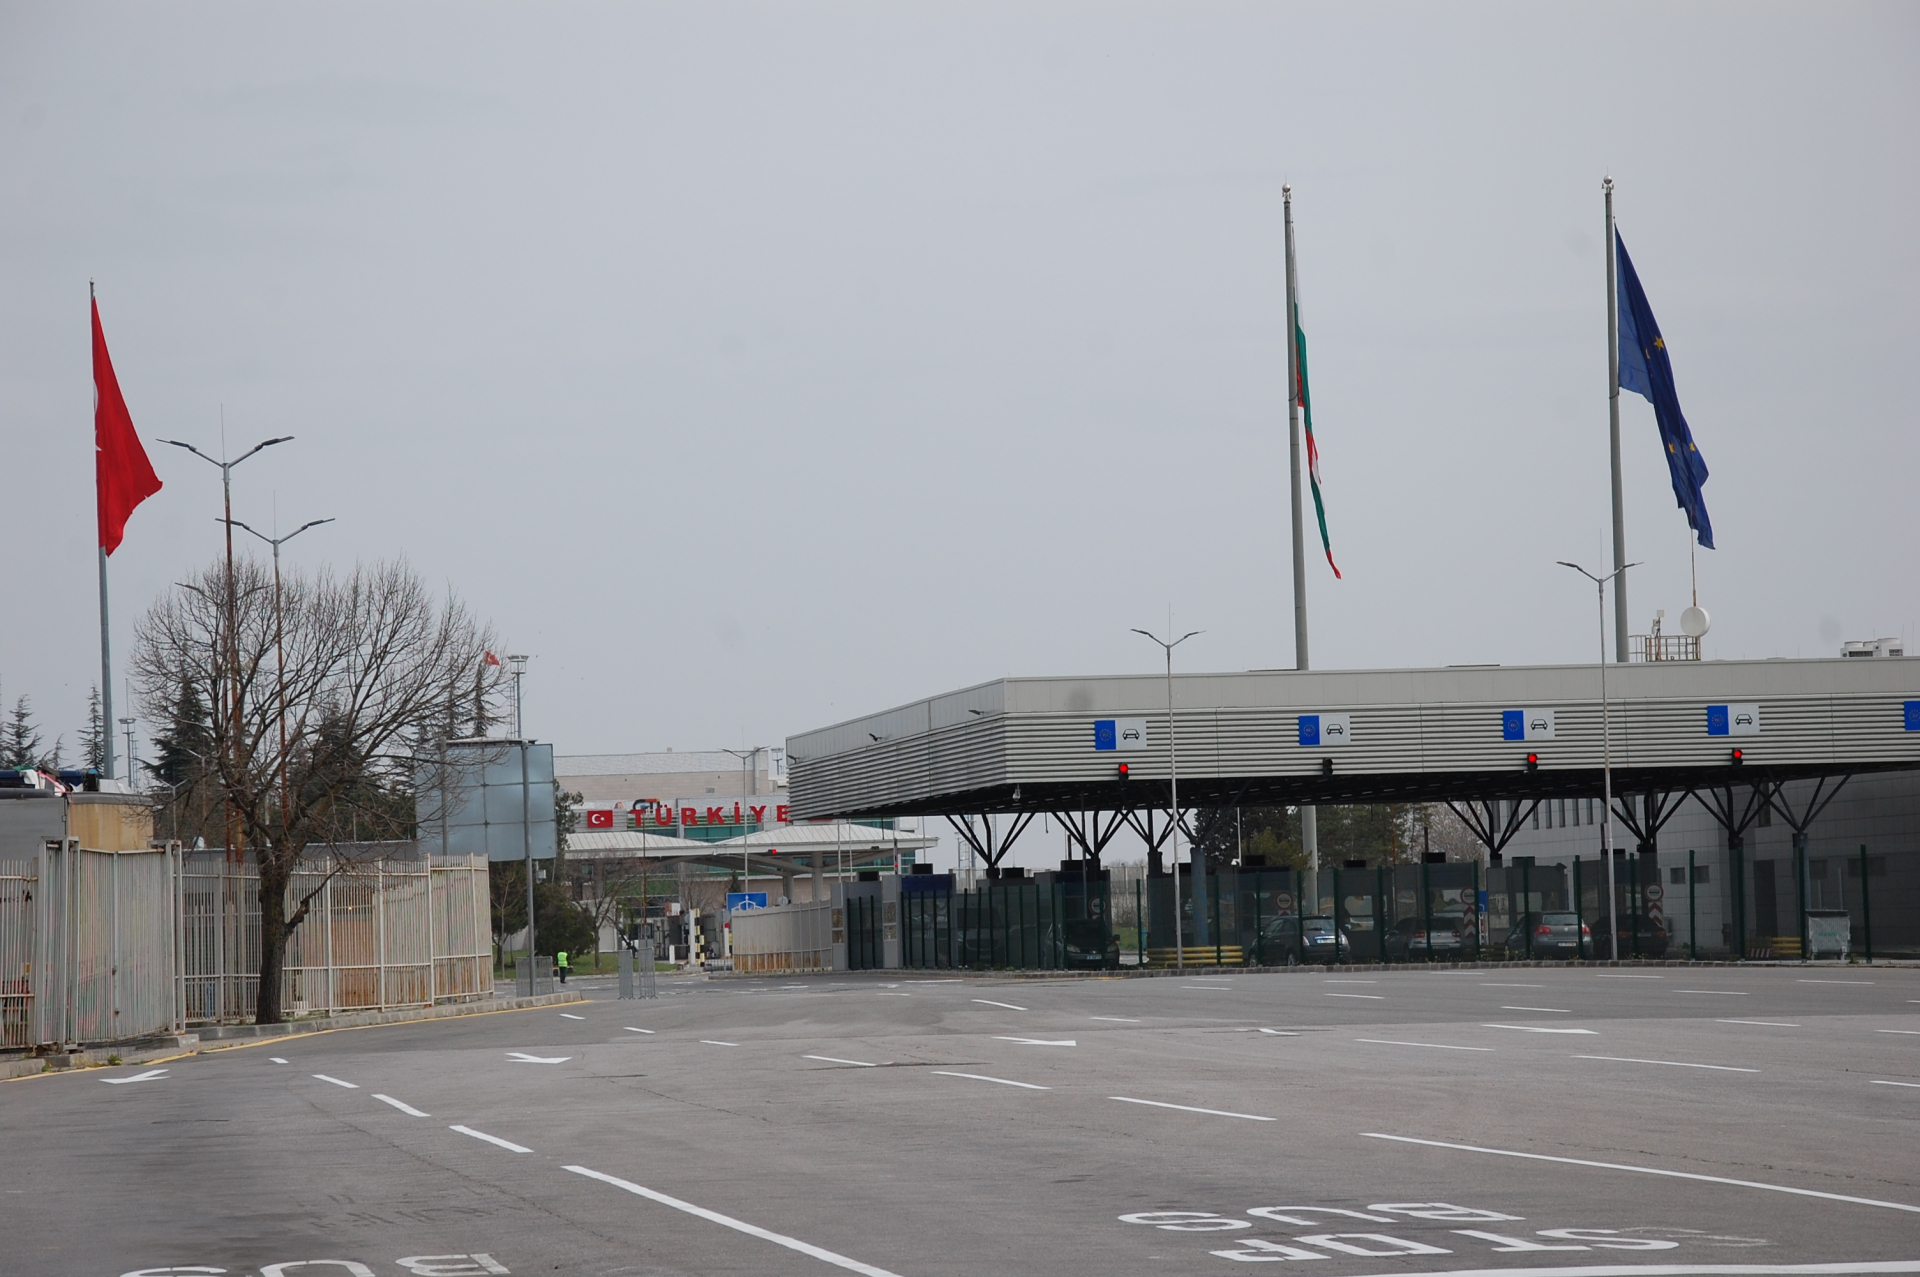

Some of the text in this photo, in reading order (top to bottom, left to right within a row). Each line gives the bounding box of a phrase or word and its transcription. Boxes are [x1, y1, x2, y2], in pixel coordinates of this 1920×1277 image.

[629, 801, 790, 827] TÜRKİYE
[1117, 1202, 1527, 1232] BUS
[1208, 1228, 1680, 1262] STOP
